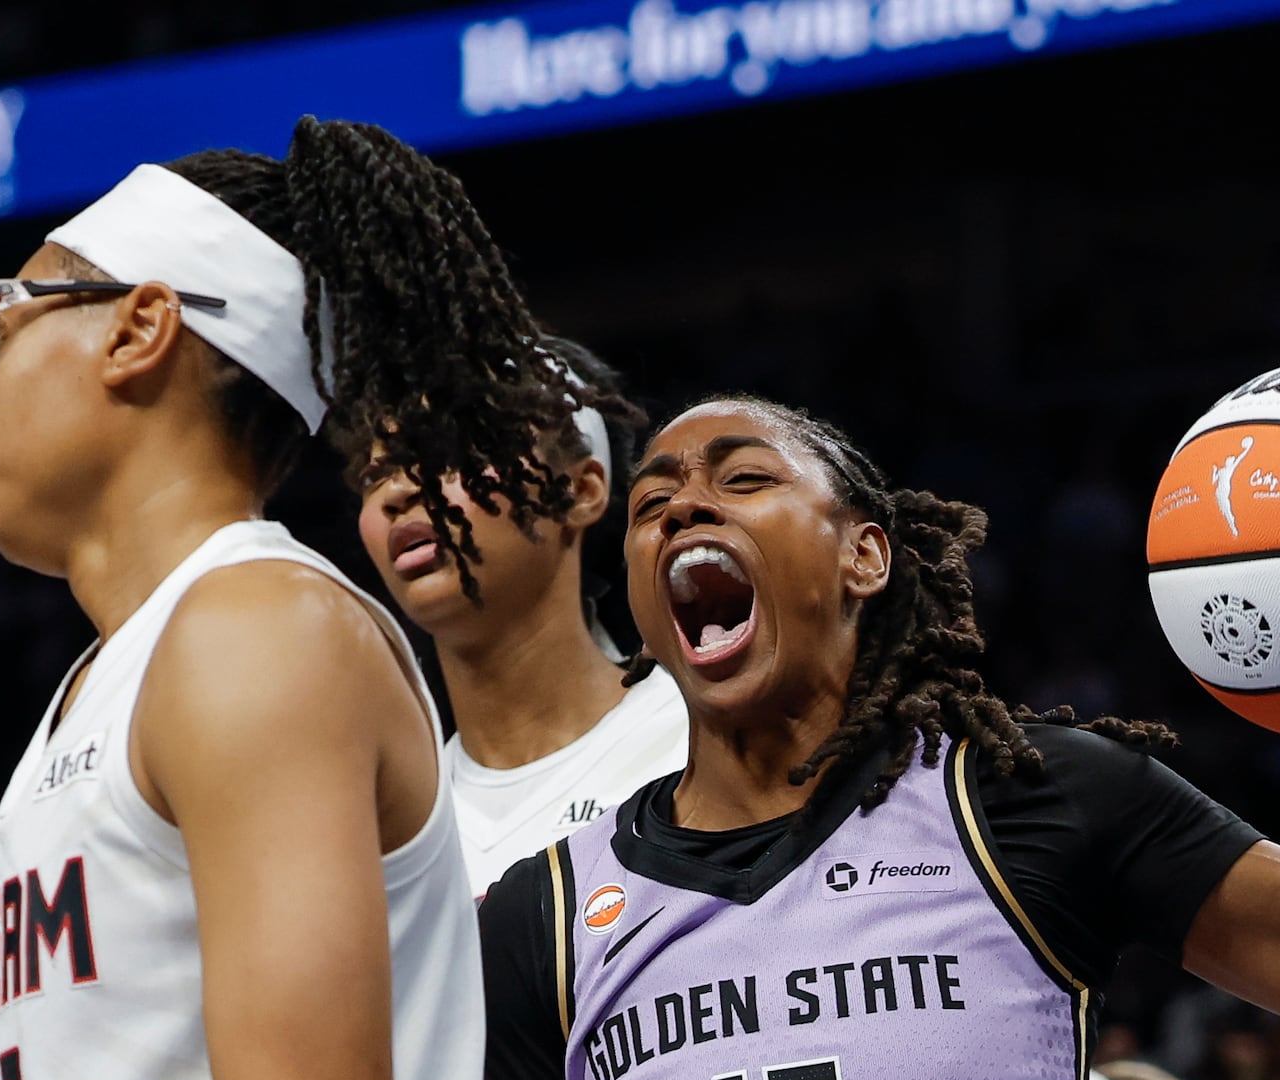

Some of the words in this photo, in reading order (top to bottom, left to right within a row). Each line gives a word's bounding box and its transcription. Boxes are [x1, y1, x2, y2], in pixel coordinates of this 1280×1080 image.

[628, 0, 732, 90] for
[867, 860, 951, 886] freedom
[785, 954, 966, 1027] STATE
